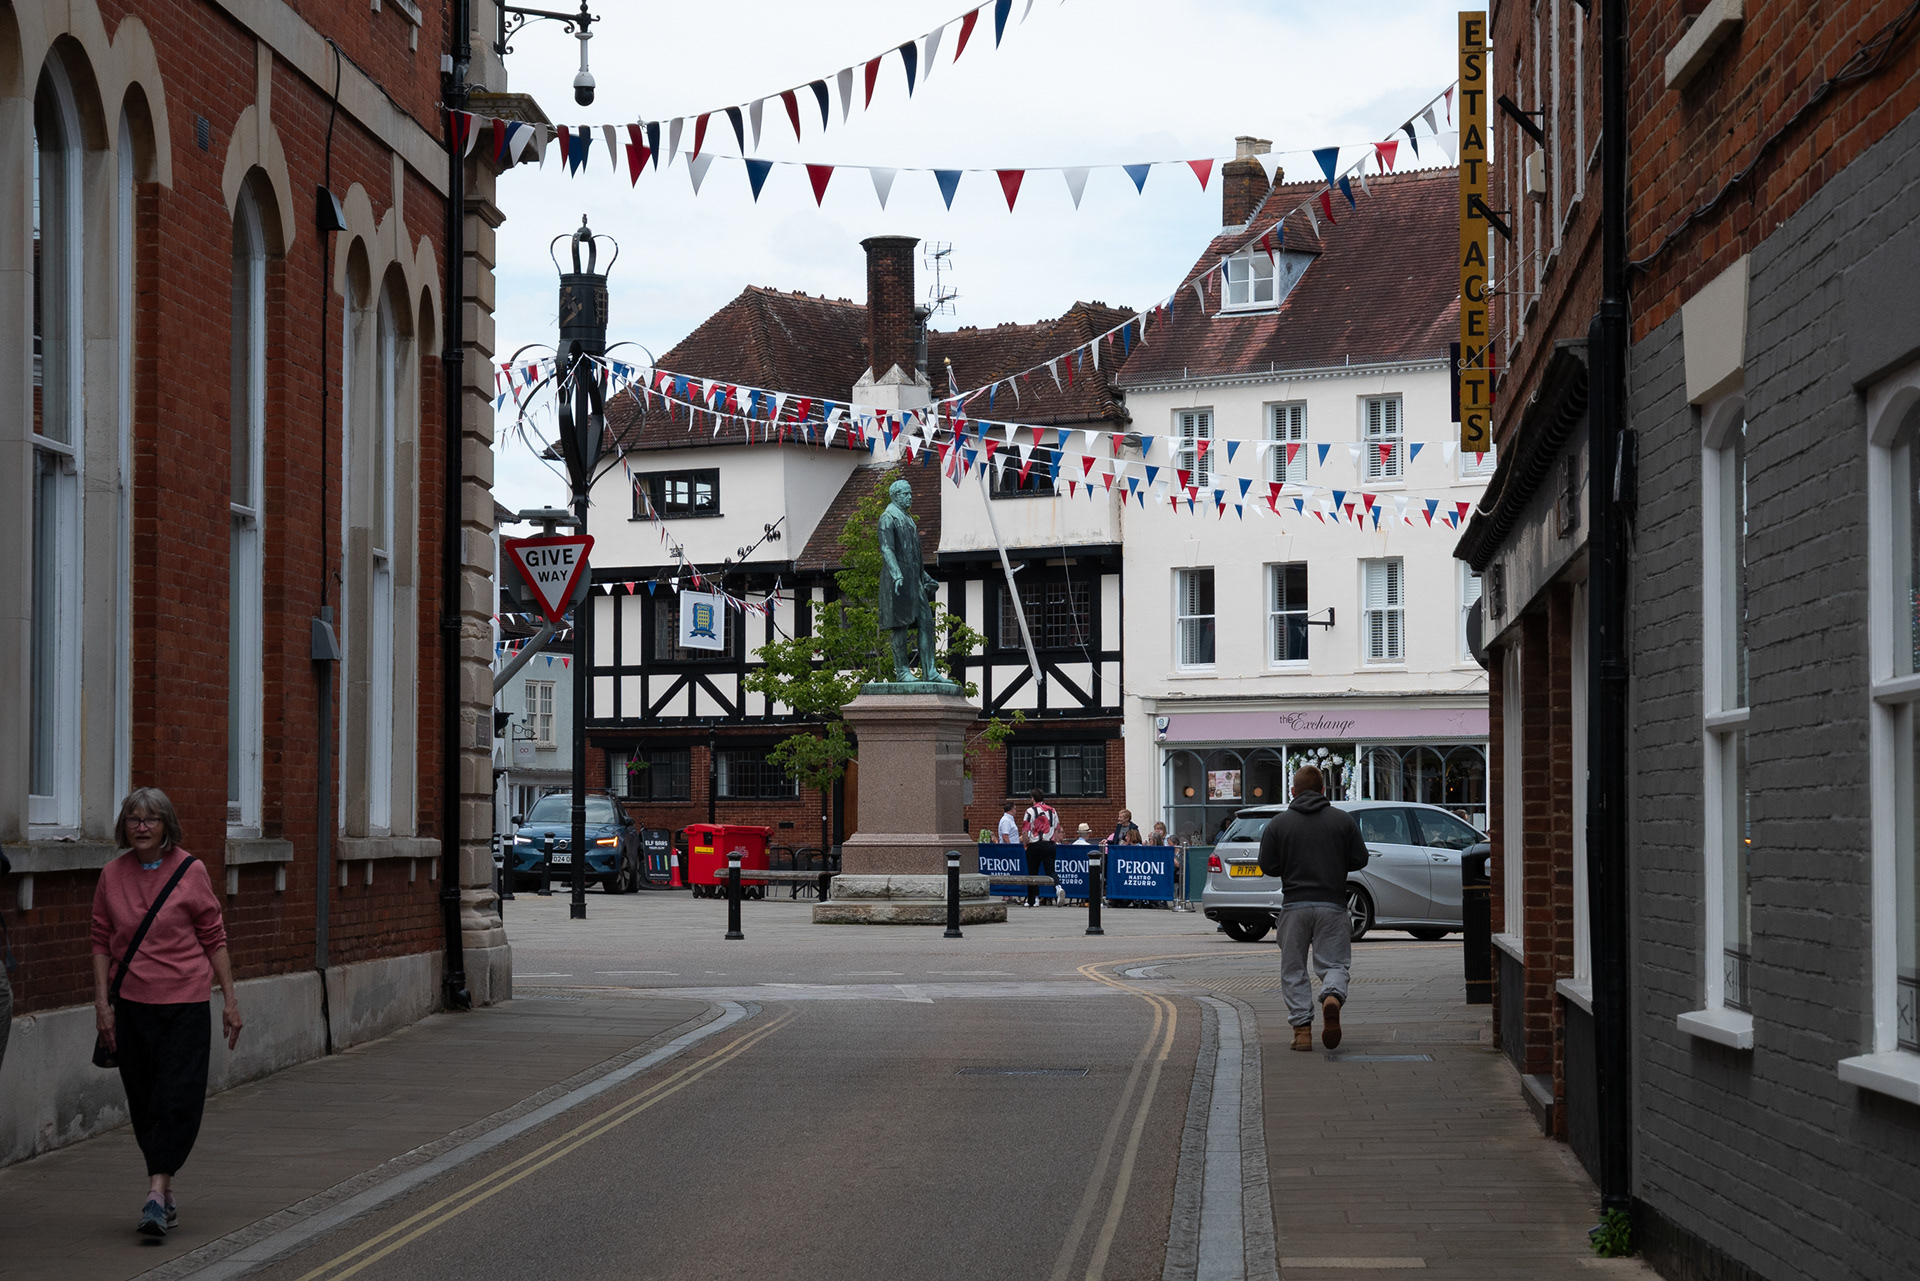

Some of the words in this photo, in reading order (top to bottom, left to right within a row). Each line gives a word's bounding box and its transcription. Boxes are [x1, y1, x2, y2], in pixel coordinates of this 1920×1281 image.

[1462, 20, 1484, 219] ESTATE
[1463, 240, 1486, 442] AGENTS
[525, 548, 574, 567] GIVE
[538, 570, 568, 582] WAY
[1279, 714, 1293, 724] the
[1288, 712, 1355, 736] Exchange
[979, 856, 1020, 872] PERONI
[1054, 860, 1089, 873] ERONI
[1117, 859, 1165, 875] PERONI
